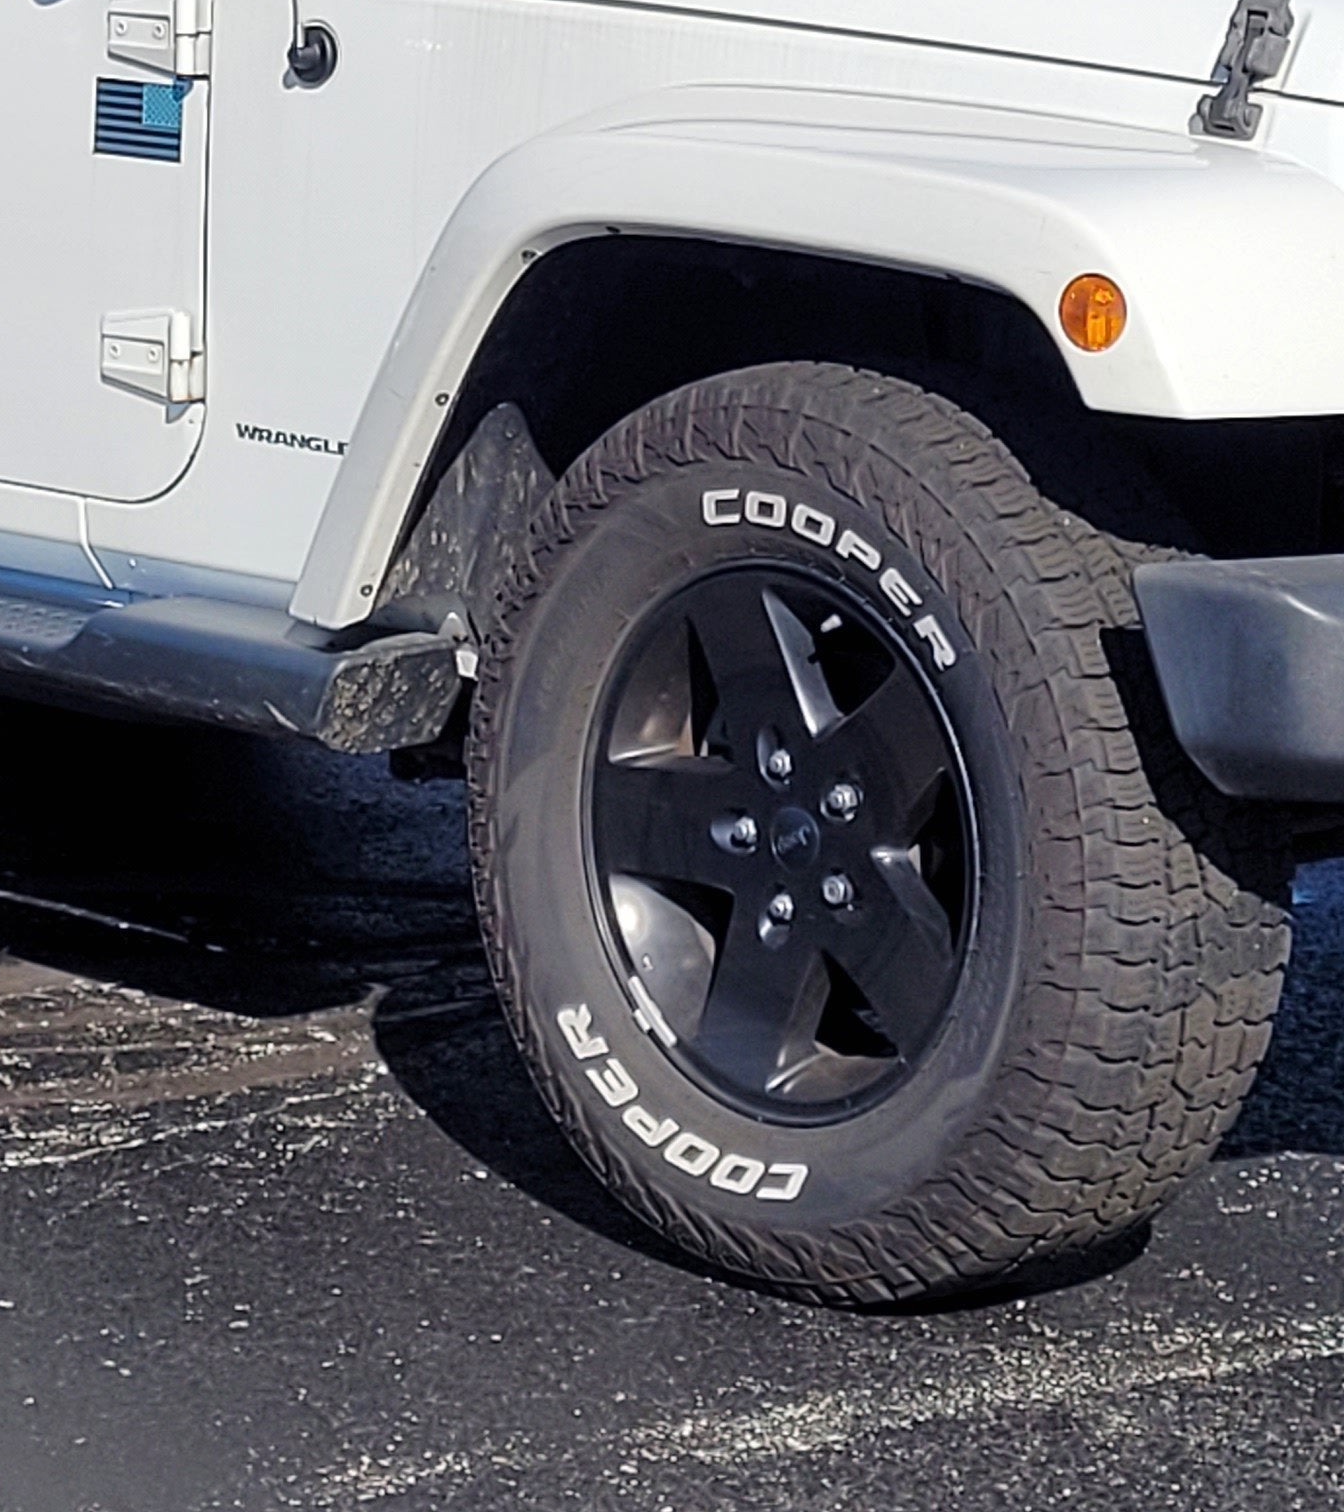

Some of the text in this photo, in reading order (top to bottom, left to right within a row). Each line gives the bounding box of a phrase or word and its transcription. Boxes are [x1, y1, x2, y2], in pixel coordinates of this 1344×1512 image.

[235, 422, 349, 456] WRANGL
[702, 488, 956, 672] COOPER
[556, 1003, 809, 1201] COOPER
